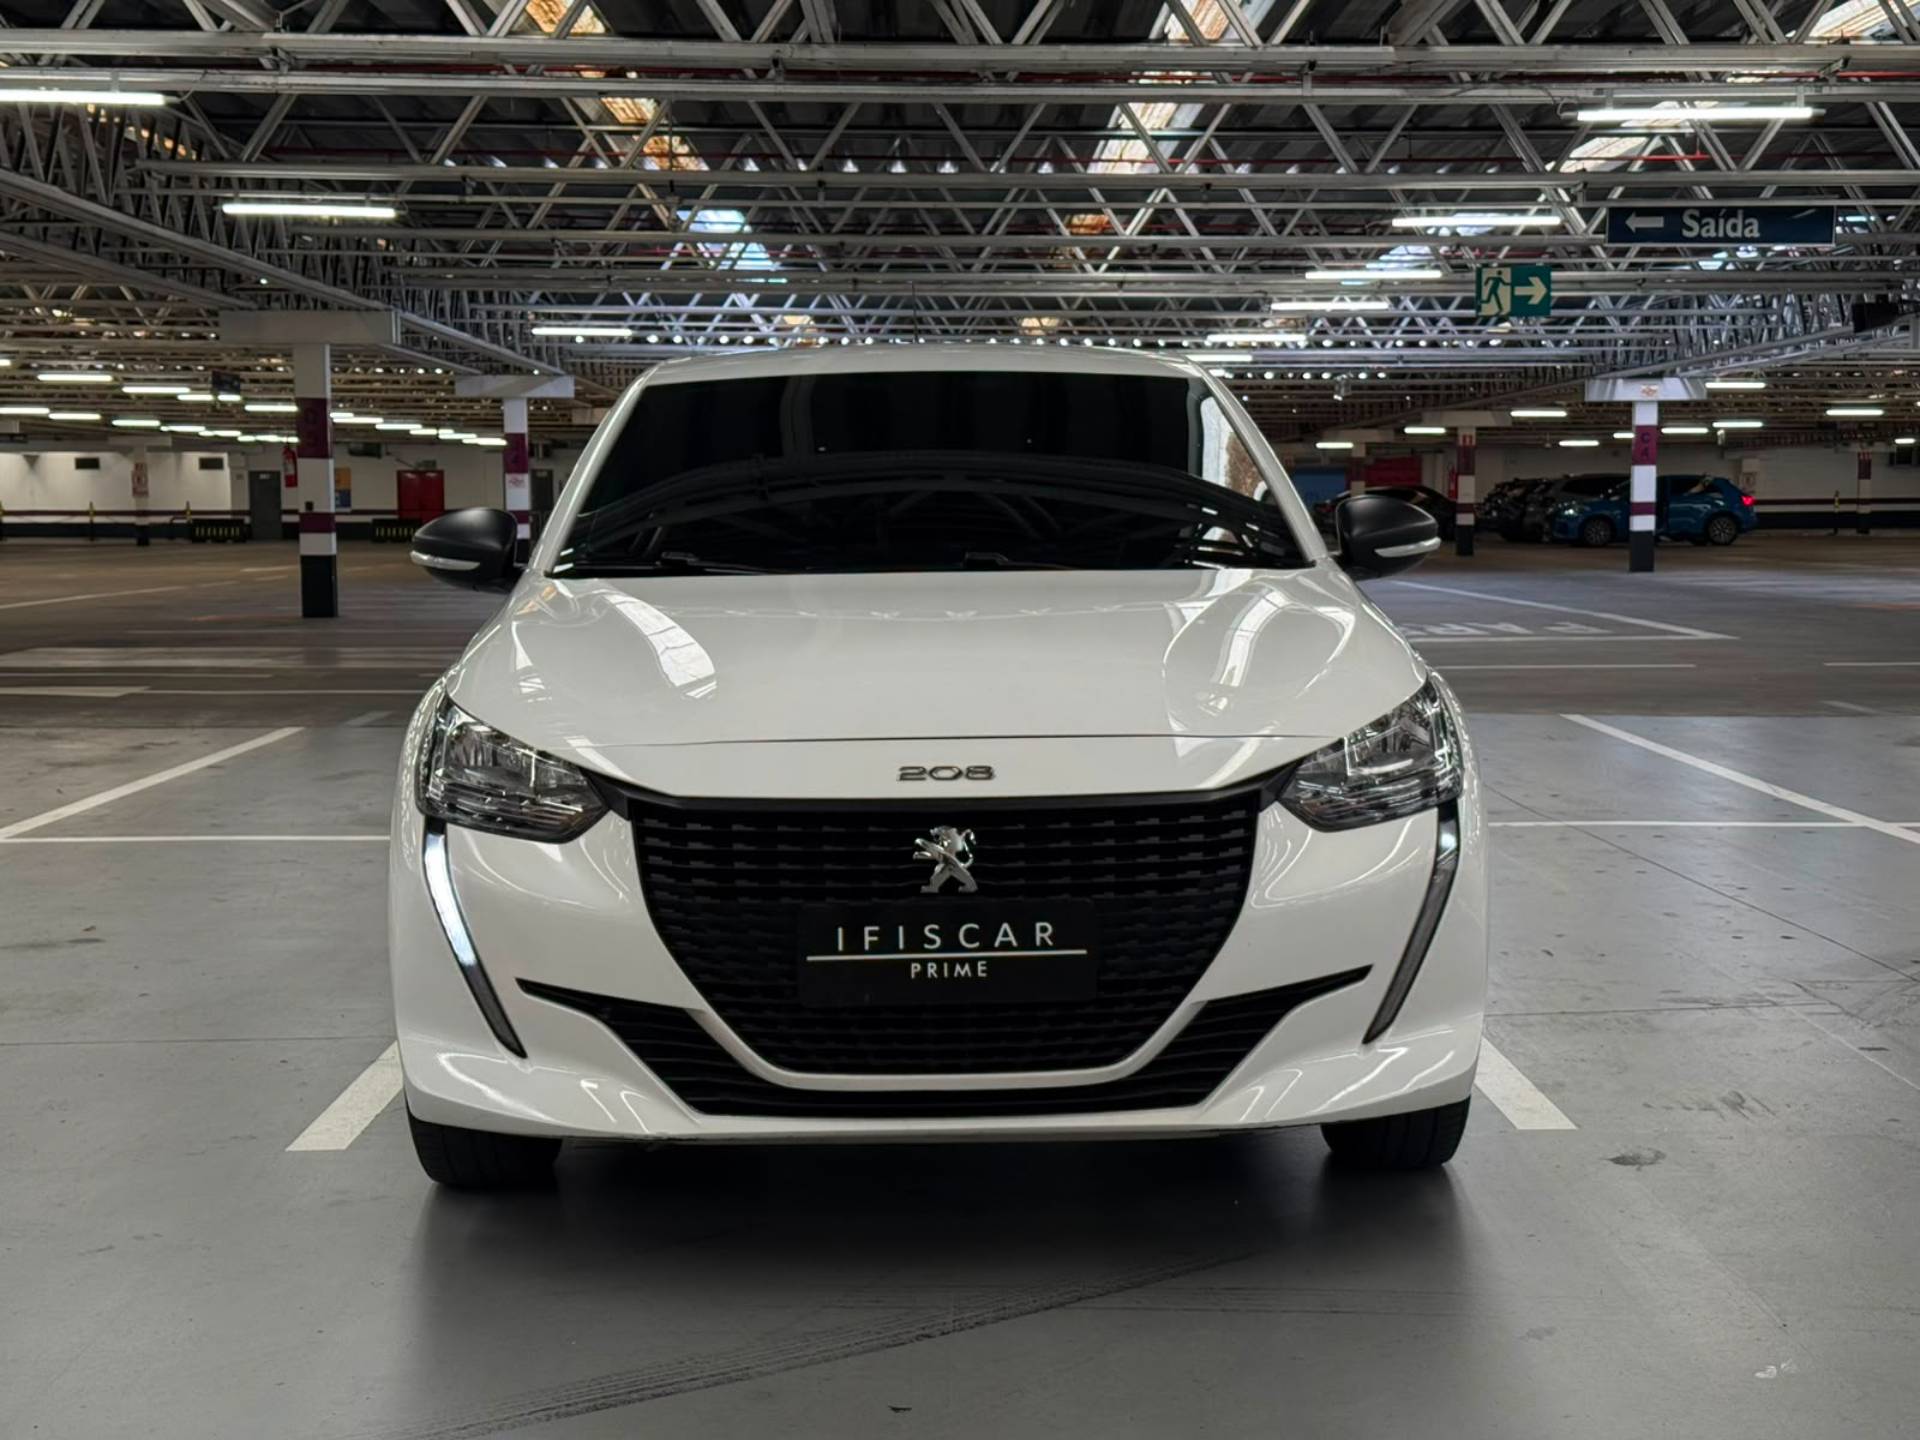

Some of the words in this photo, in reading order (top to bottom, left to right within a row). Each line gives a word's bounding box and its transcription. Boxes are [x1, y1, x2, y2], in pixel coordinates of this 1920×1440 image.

[1681, 208, 1760, 238] Saída
[897, 765, 995, 782] 208
[837, 922, 1055, 952] IFISCAR
[910, 960, 989, 979] PRIME
